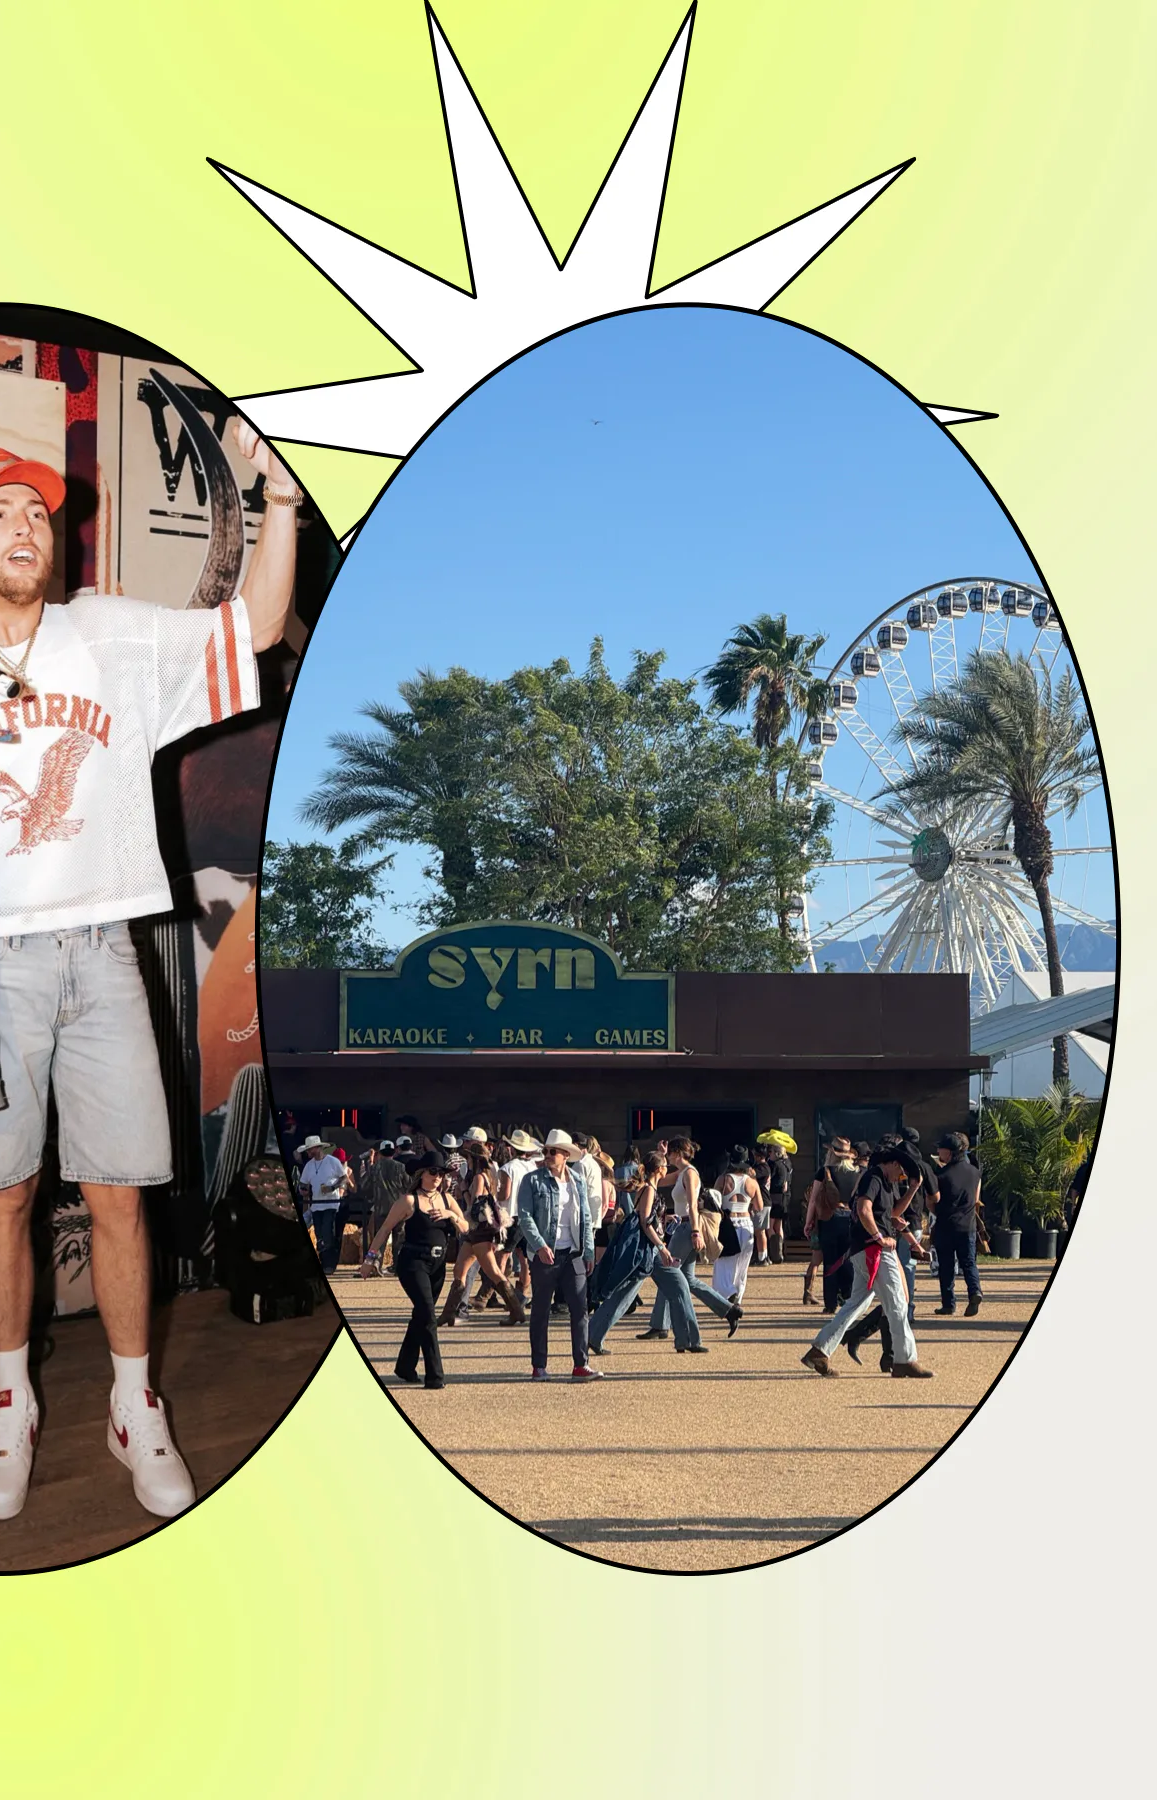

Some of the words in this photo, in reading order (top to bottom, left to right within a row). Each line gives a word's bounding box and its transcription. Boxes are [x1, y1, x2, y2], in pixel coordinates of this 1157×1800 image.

[428, 945, 595, 1010] syrn
[348, 1028, 448, 1045] KARAOKE
[501, 1028, 543, 1045] BAR
[595, 1028, 666, 1046] GAMES
